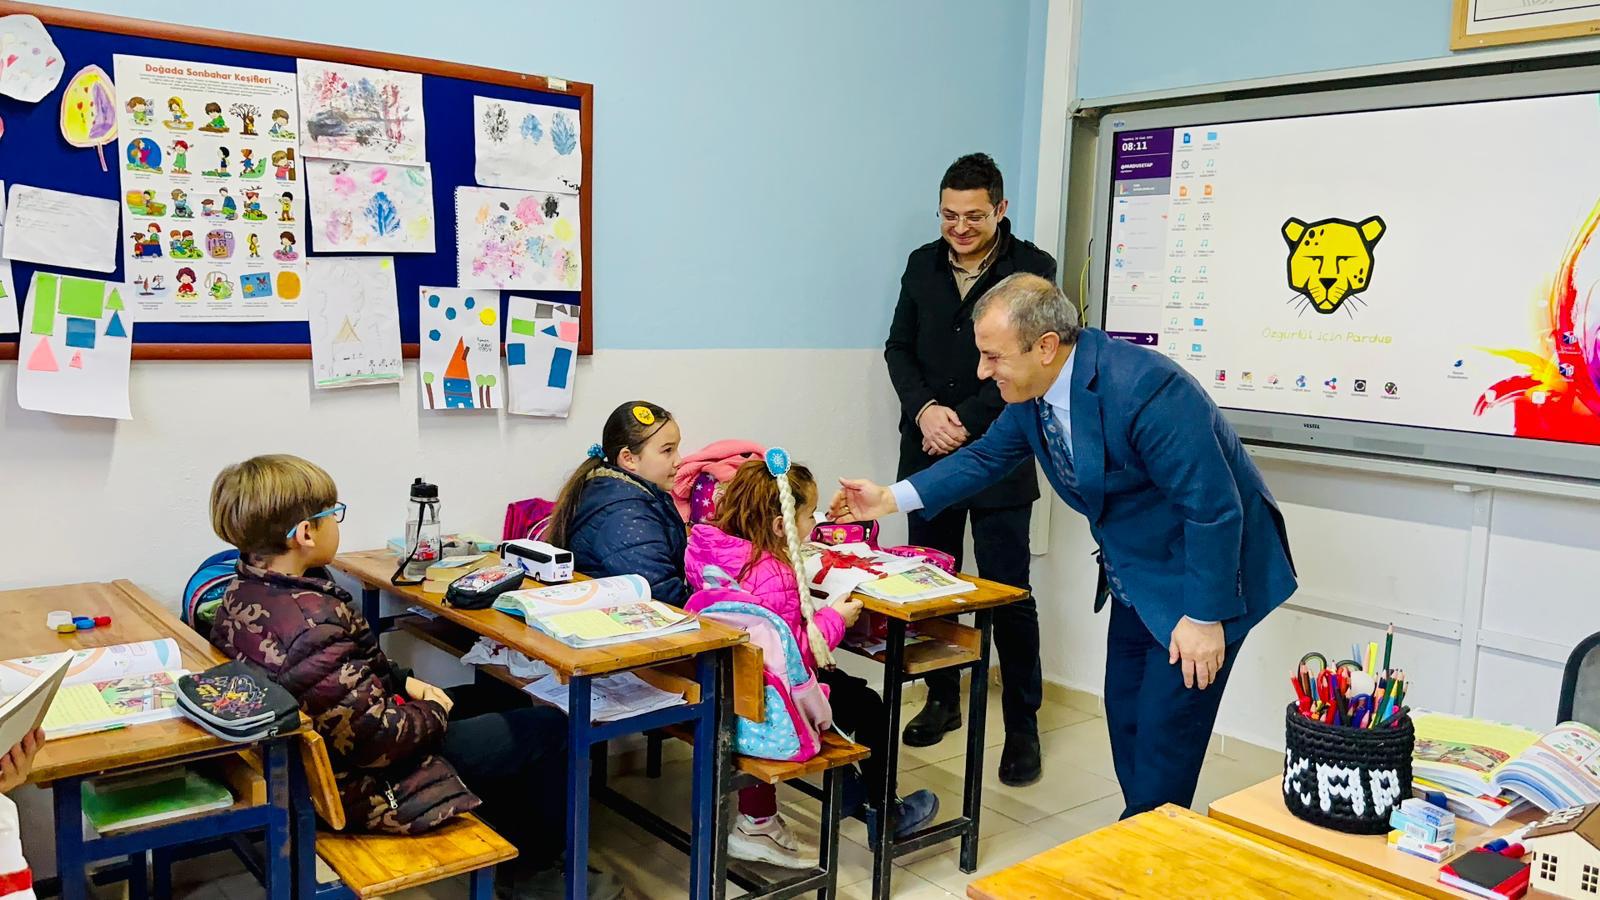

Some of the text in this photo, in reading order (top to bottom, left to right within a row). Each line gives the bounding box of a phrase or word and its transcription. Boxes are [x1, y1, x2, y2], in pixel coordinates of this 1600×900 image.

[145, 63, 184, 76] Doğada
[186, 65, 232, 80] Sonbahar
[234, 73, 272, 85] Keşifleri
[1122, 141, 1148, 151] 08:11
[1346, 331, 1393, 345] Pardus
